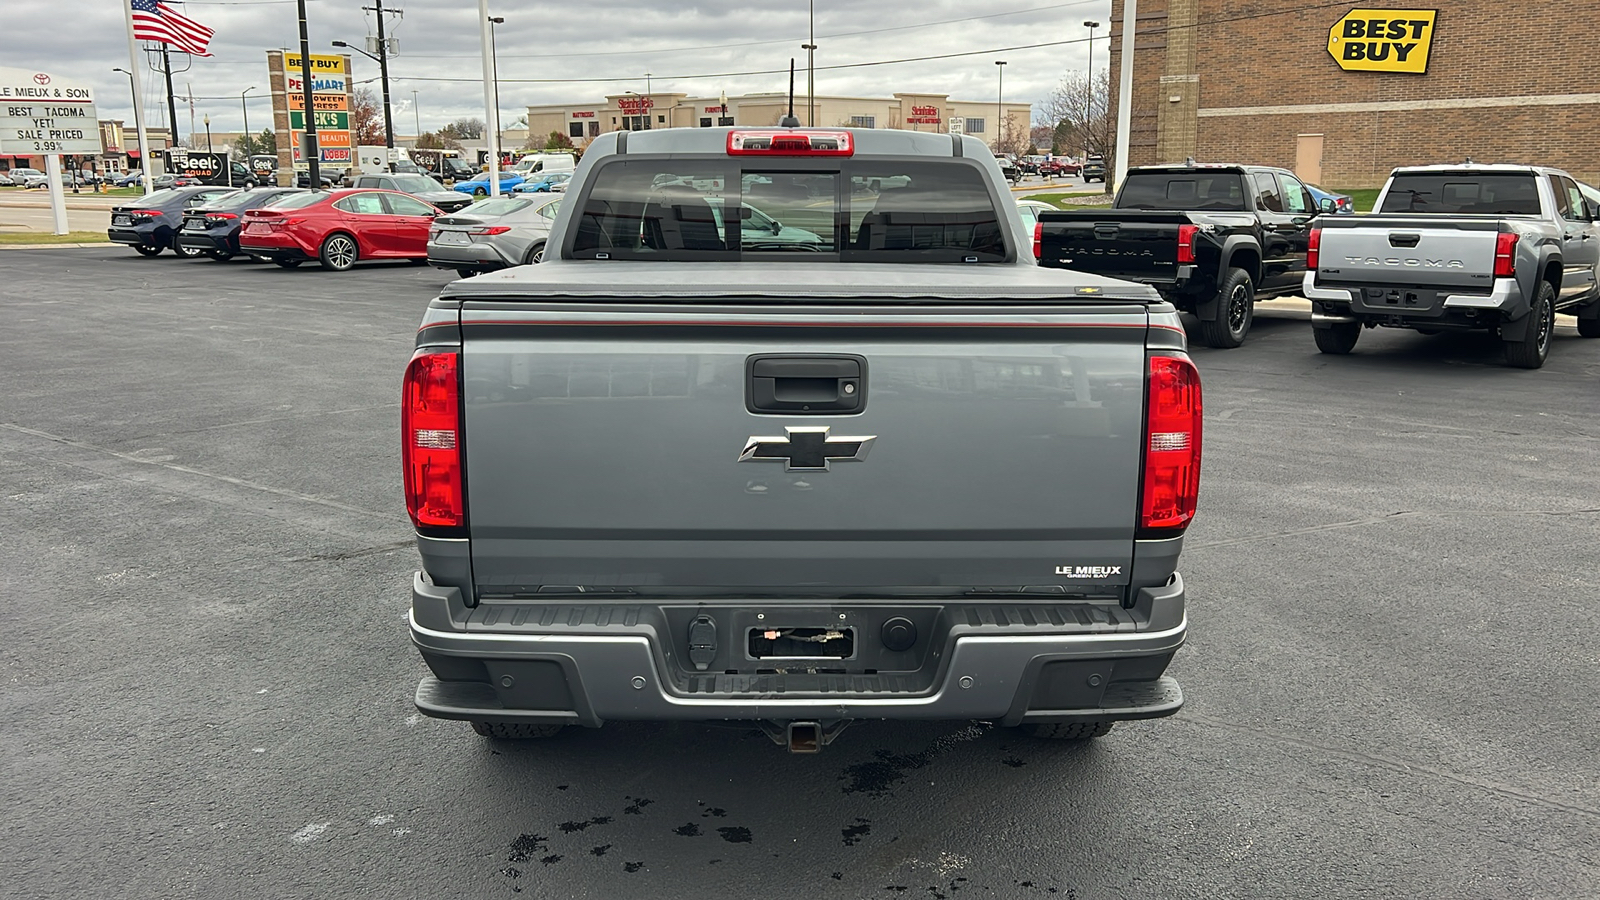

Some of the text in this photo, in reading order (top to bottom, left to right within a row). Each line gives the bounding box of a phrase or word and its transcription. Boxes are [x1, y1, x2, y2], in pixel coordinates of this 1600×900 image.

[1342, 19, 1430, 40] BEST
[1342, 42, 1418, 62] BUY
[288, 58, 340, 69] BET BUY
[15, 88, 50, 98] MIEUX
[53, 88, 62, 98] &
[66, 89, 89, 98] SON
[8, 107, 85, 117] BEST TACOMA
[33, 119, 55, 128] YET!
[301, 112, 338, 125] DCK'S
[17, 130, 83, 139] SALE PRICED
[321, 134, 349, 142] BEAUTY
[33, 141, 63, 151] 3.99%
[324, 150, 349, 159] LOBBY
[414, 153, 436, 165] Geek
[253, 159, 273, 170] Geek
[1061, 247, 1154, 256] TACOMA
[1345, 256, 1464, 269] TACOMA
[1055, 566, 1121, 574] LE MIEUX
